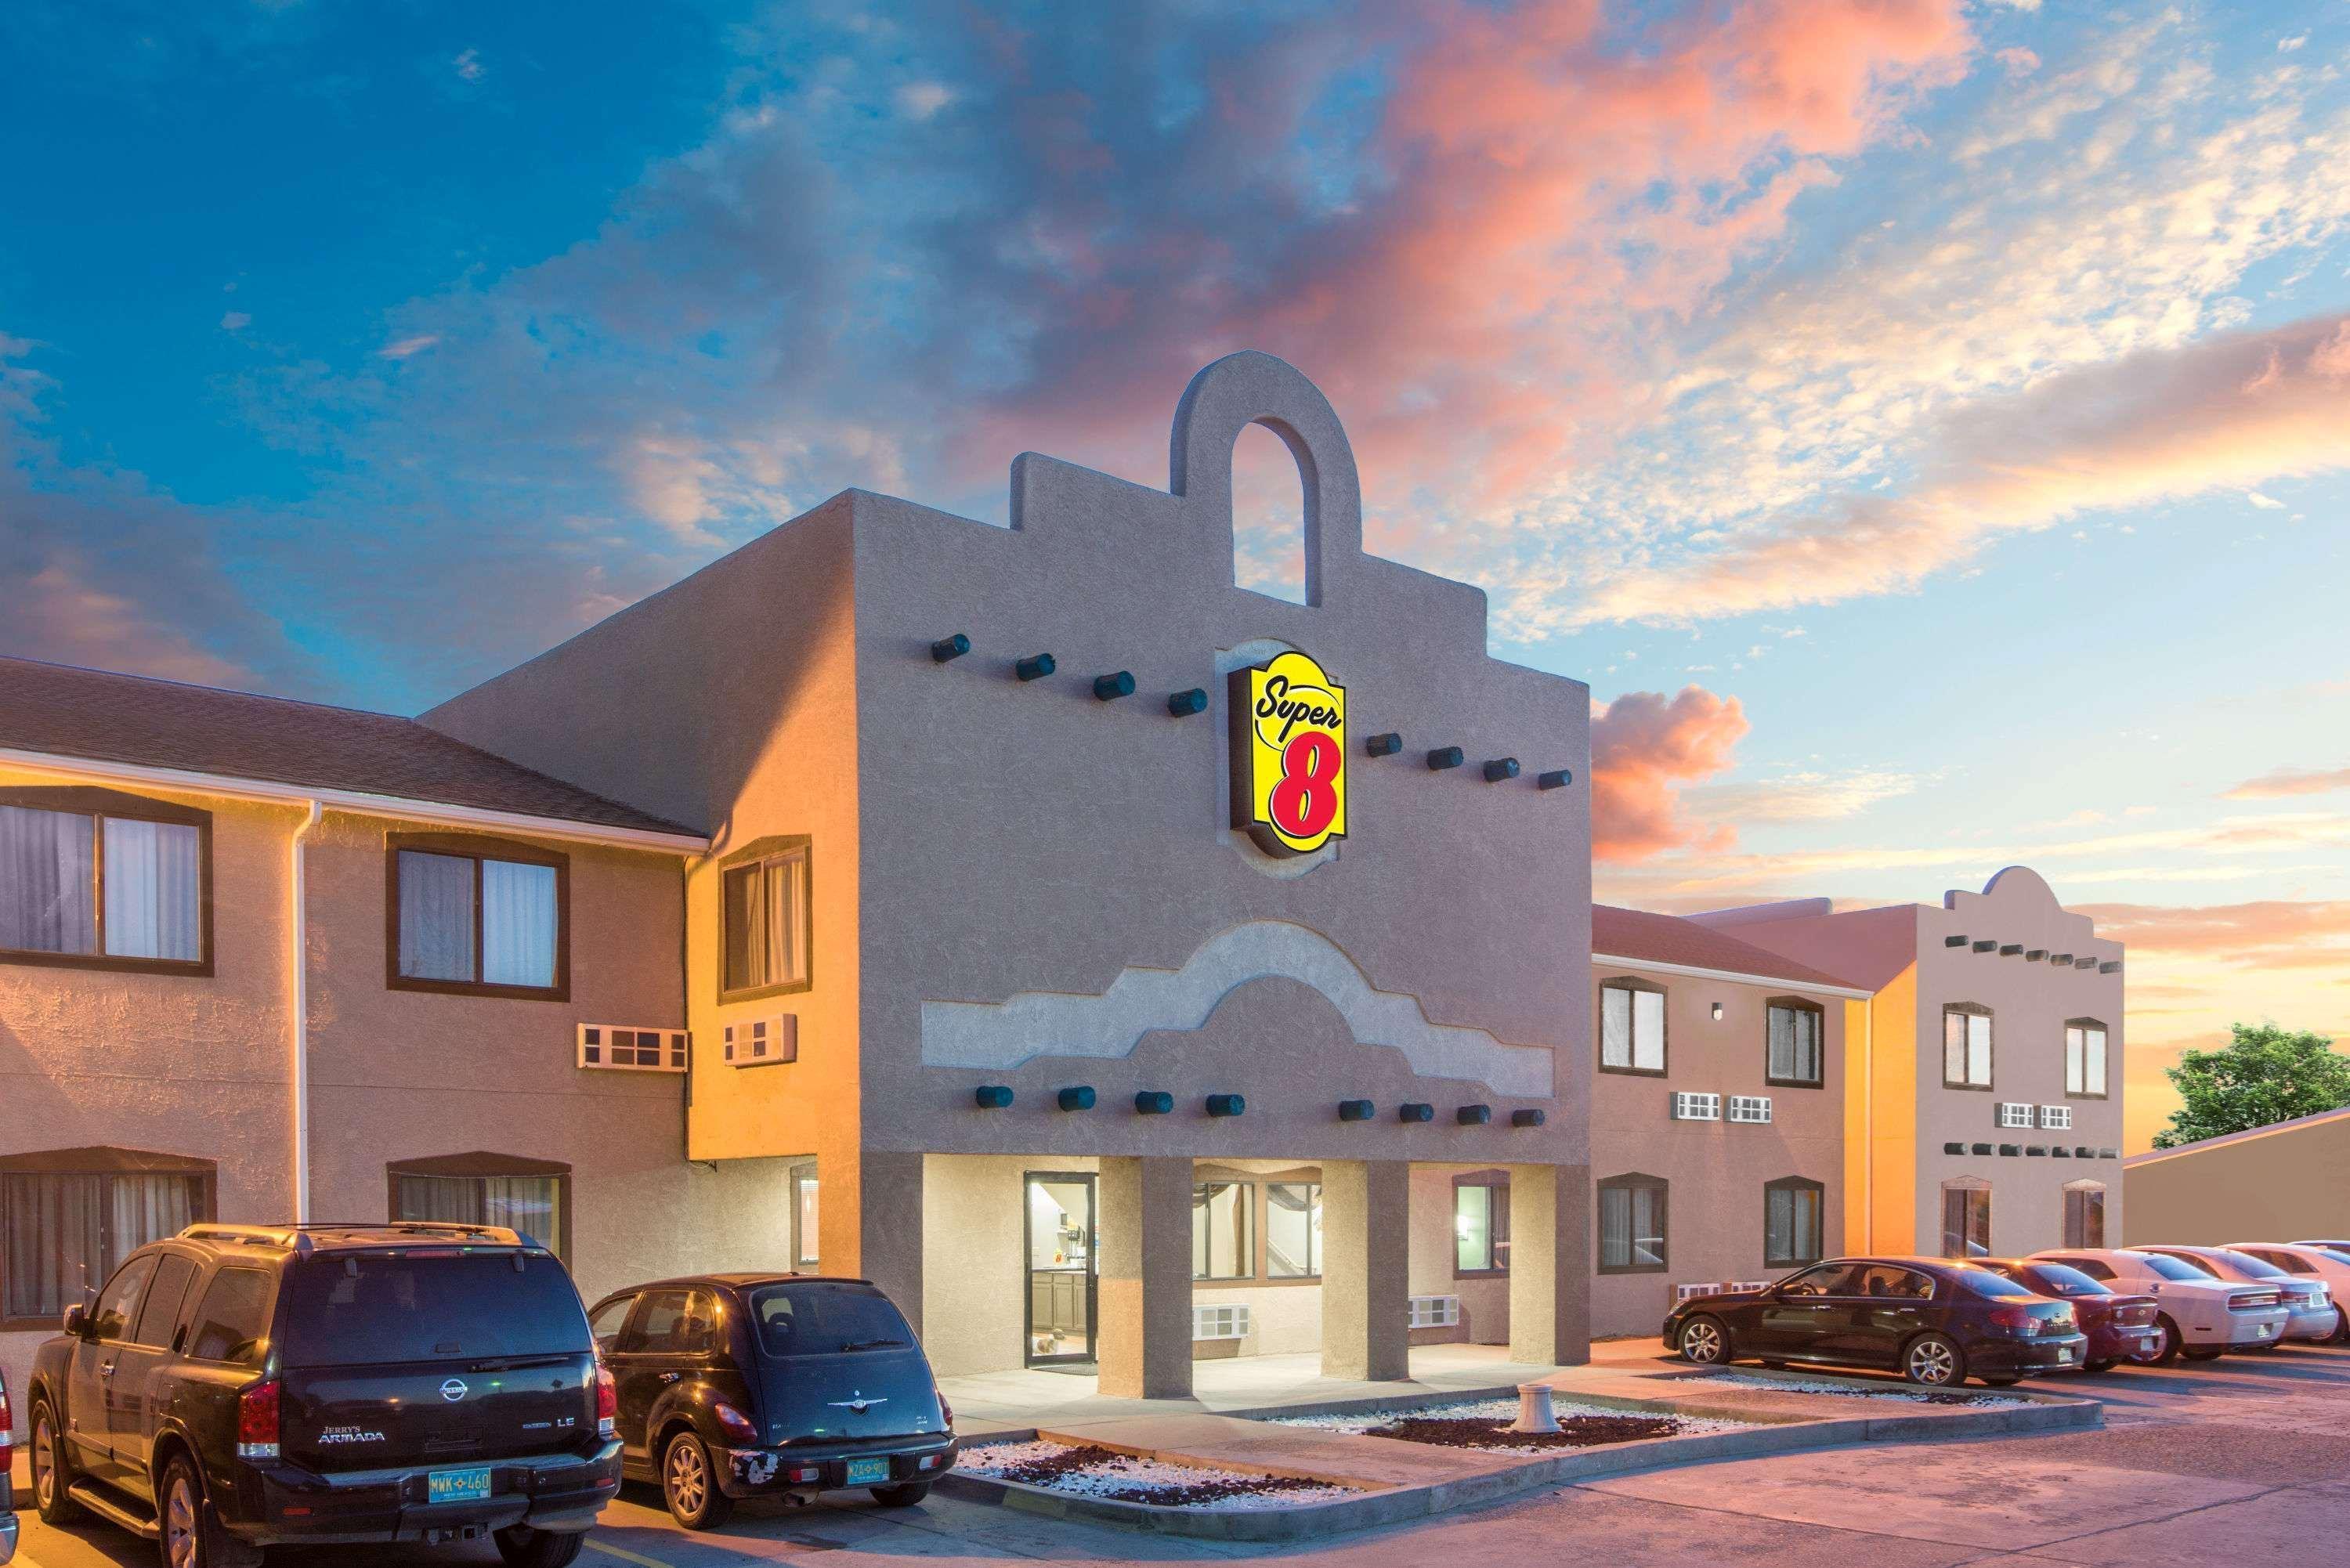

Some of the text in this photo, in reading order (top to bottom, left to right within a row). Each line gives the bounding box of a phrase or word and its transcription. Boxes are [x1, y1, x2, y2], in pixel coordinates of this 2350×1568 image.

[1256, 674, 1342, 743] Super
[1268, 731, 1341, 840] 8
[323, 1425, 360, 1435] JERRY'S
[557, 1418, 575, 1428] LE
[318, 1432, 385, 1443] ARMADA
[468, 1473, 489, 1490] 460
